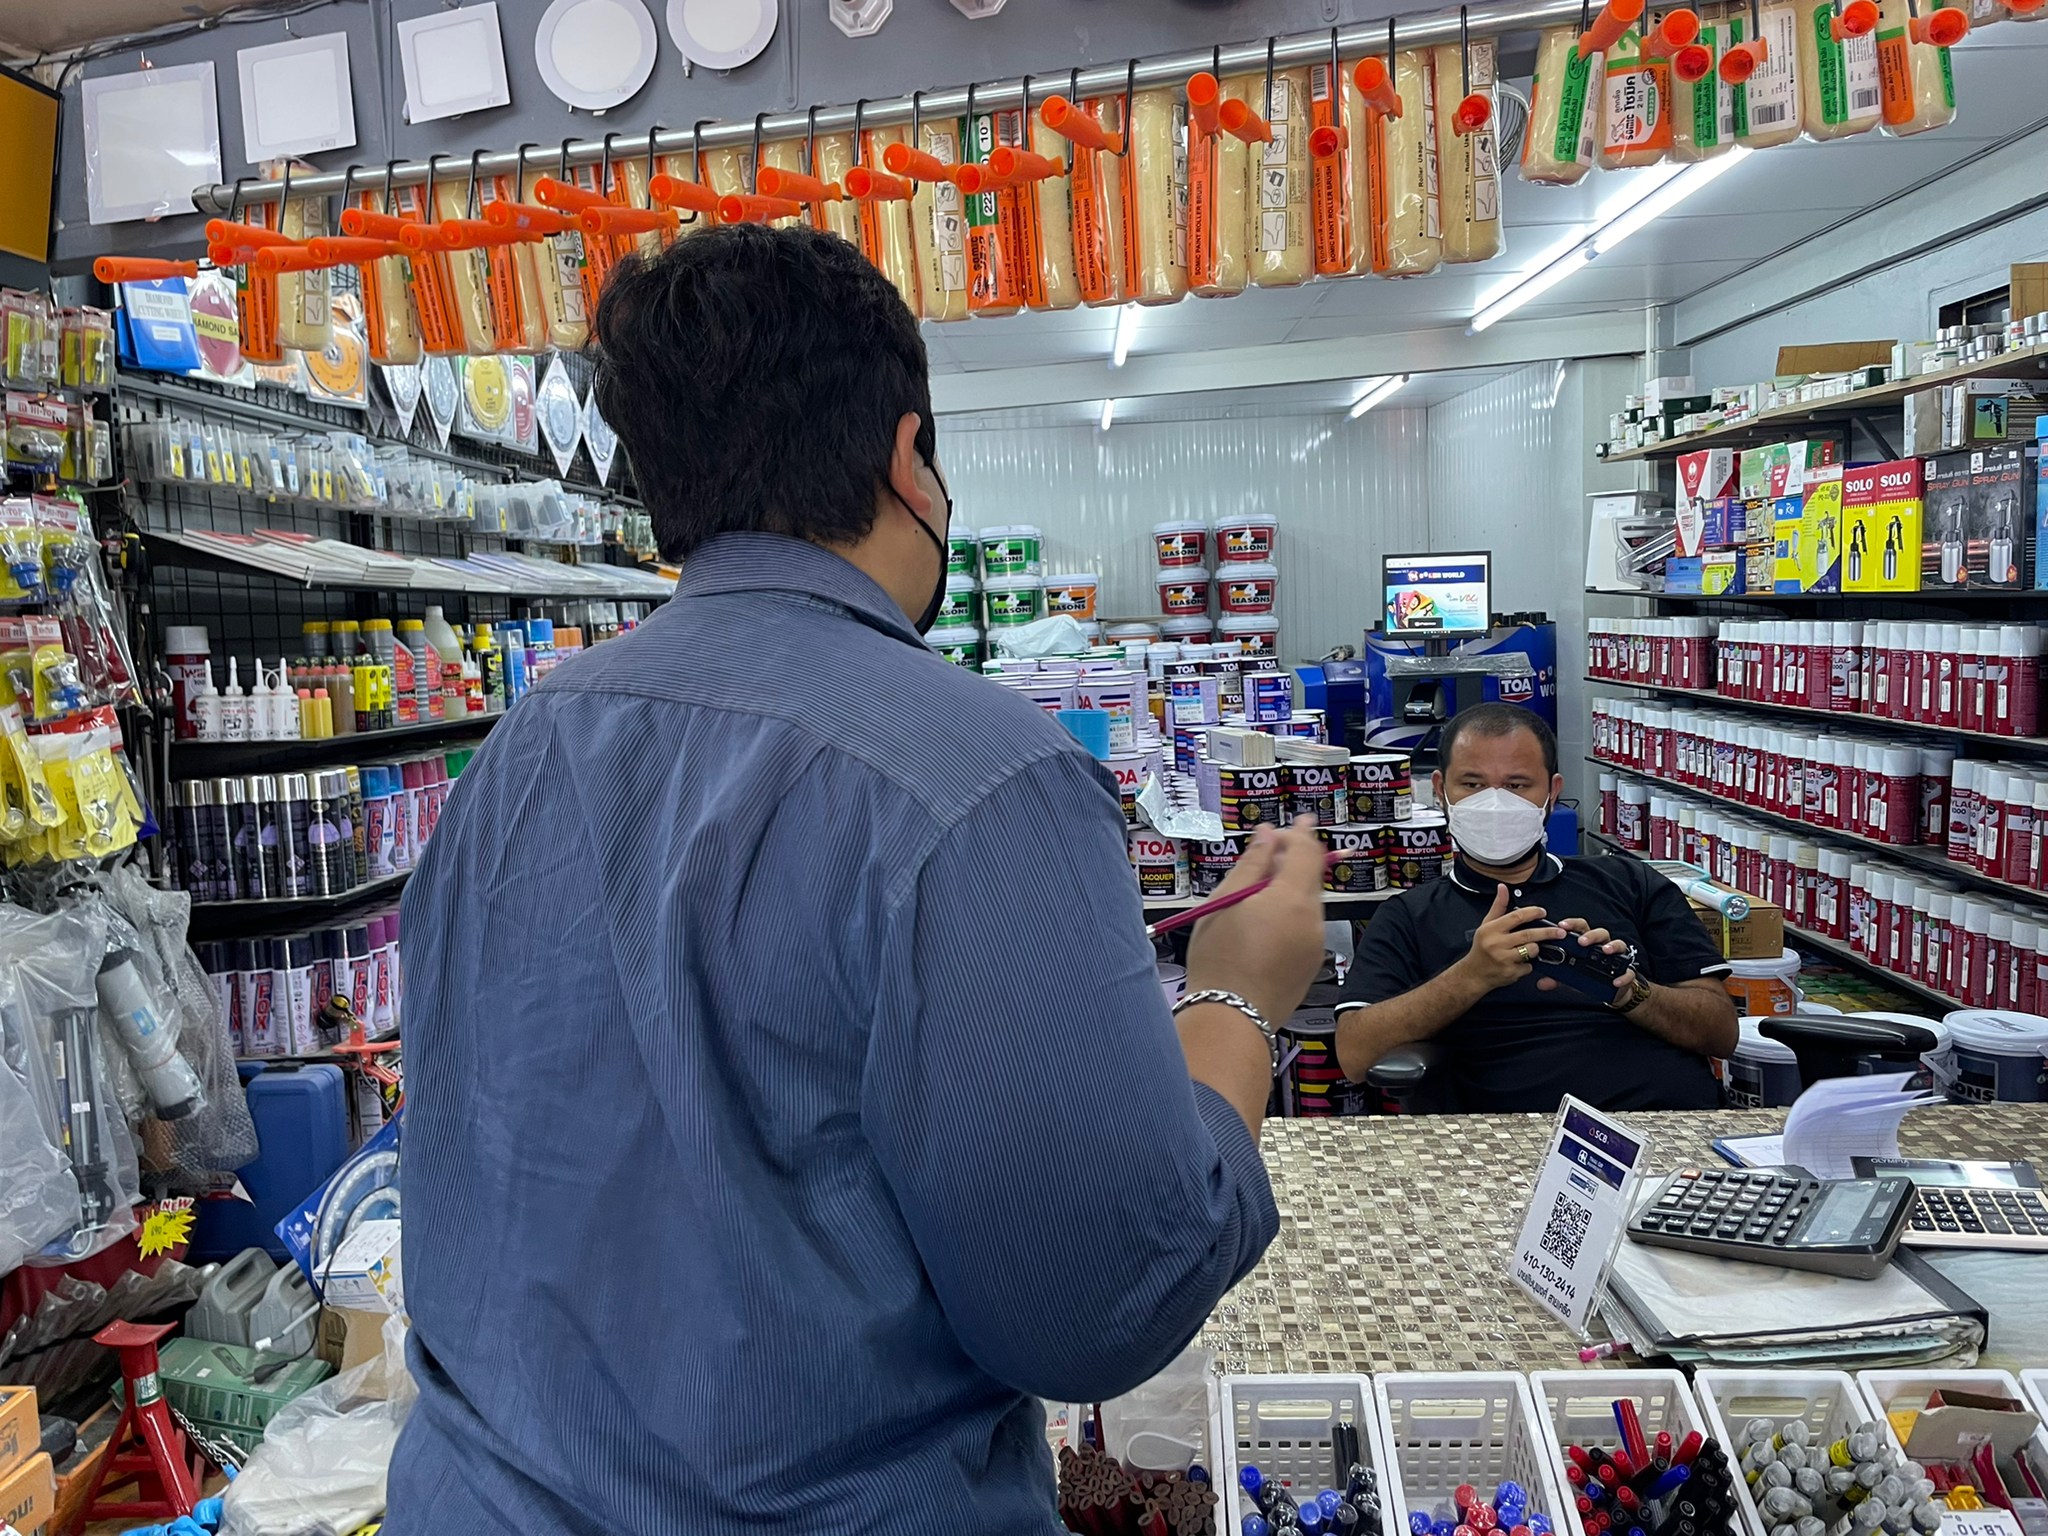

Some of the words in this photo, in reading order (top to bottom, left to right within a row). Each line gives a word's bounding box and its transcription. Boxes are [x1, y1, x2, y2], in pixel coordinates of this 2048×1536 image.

[1624, 75, 1636, 112] โซมิค
[1846, 479, 1874, 493] SOLO
[1880, 472, 1911, 488] SOLO
[1927, 482, 1949, 491] SPRAY
[1951, 479, 1969, 488] GUN
[1973, 475, 1998, 485] SPRAY
[2001, 472, 2019, 481] GUN
[1161, 548, 1199, 558] SEASONS
[1229, 543, 1268, 553] SEASONS
[1231, 595, 1271, 605] SEASONS
[994, 605, 1033, 615] SEASONS
[1176, 666, 1196, 674] TOA
[1221, 663, 1239, 672] TOA
[1258, 661, 1276, 669] TOA
[1278, 678, 1292, 691] TO
[1501, 678, 1532, 693] TOA
[1239, 771, 1278, 789] TOA
[1293, 768, 1334, 785] TOA
[1354, 765, 1394, 781] TOA
[369, 810, 382, 853] FOX
[396, 806, 406, 847] FOX
[1332, 834, 1374, 850] TOA
[1399, 830, 1441, 847] TOA
[1137, 840, 1175, 856] TOA
[1200, 839, 1239, 855] TOA
[1406, 847, 1436, 855] GLIPTON
[1140, 873, 1175, 881] LACQUER
[378, 963, 388, 1006] FOX
[355, 971, 368, 1016] FOX
[256, 984, 270, 1030] FOX
[1594, 1130, 1608, 1143] SCB
[1522, 1250, 1576, 1299] 410-130-2414
